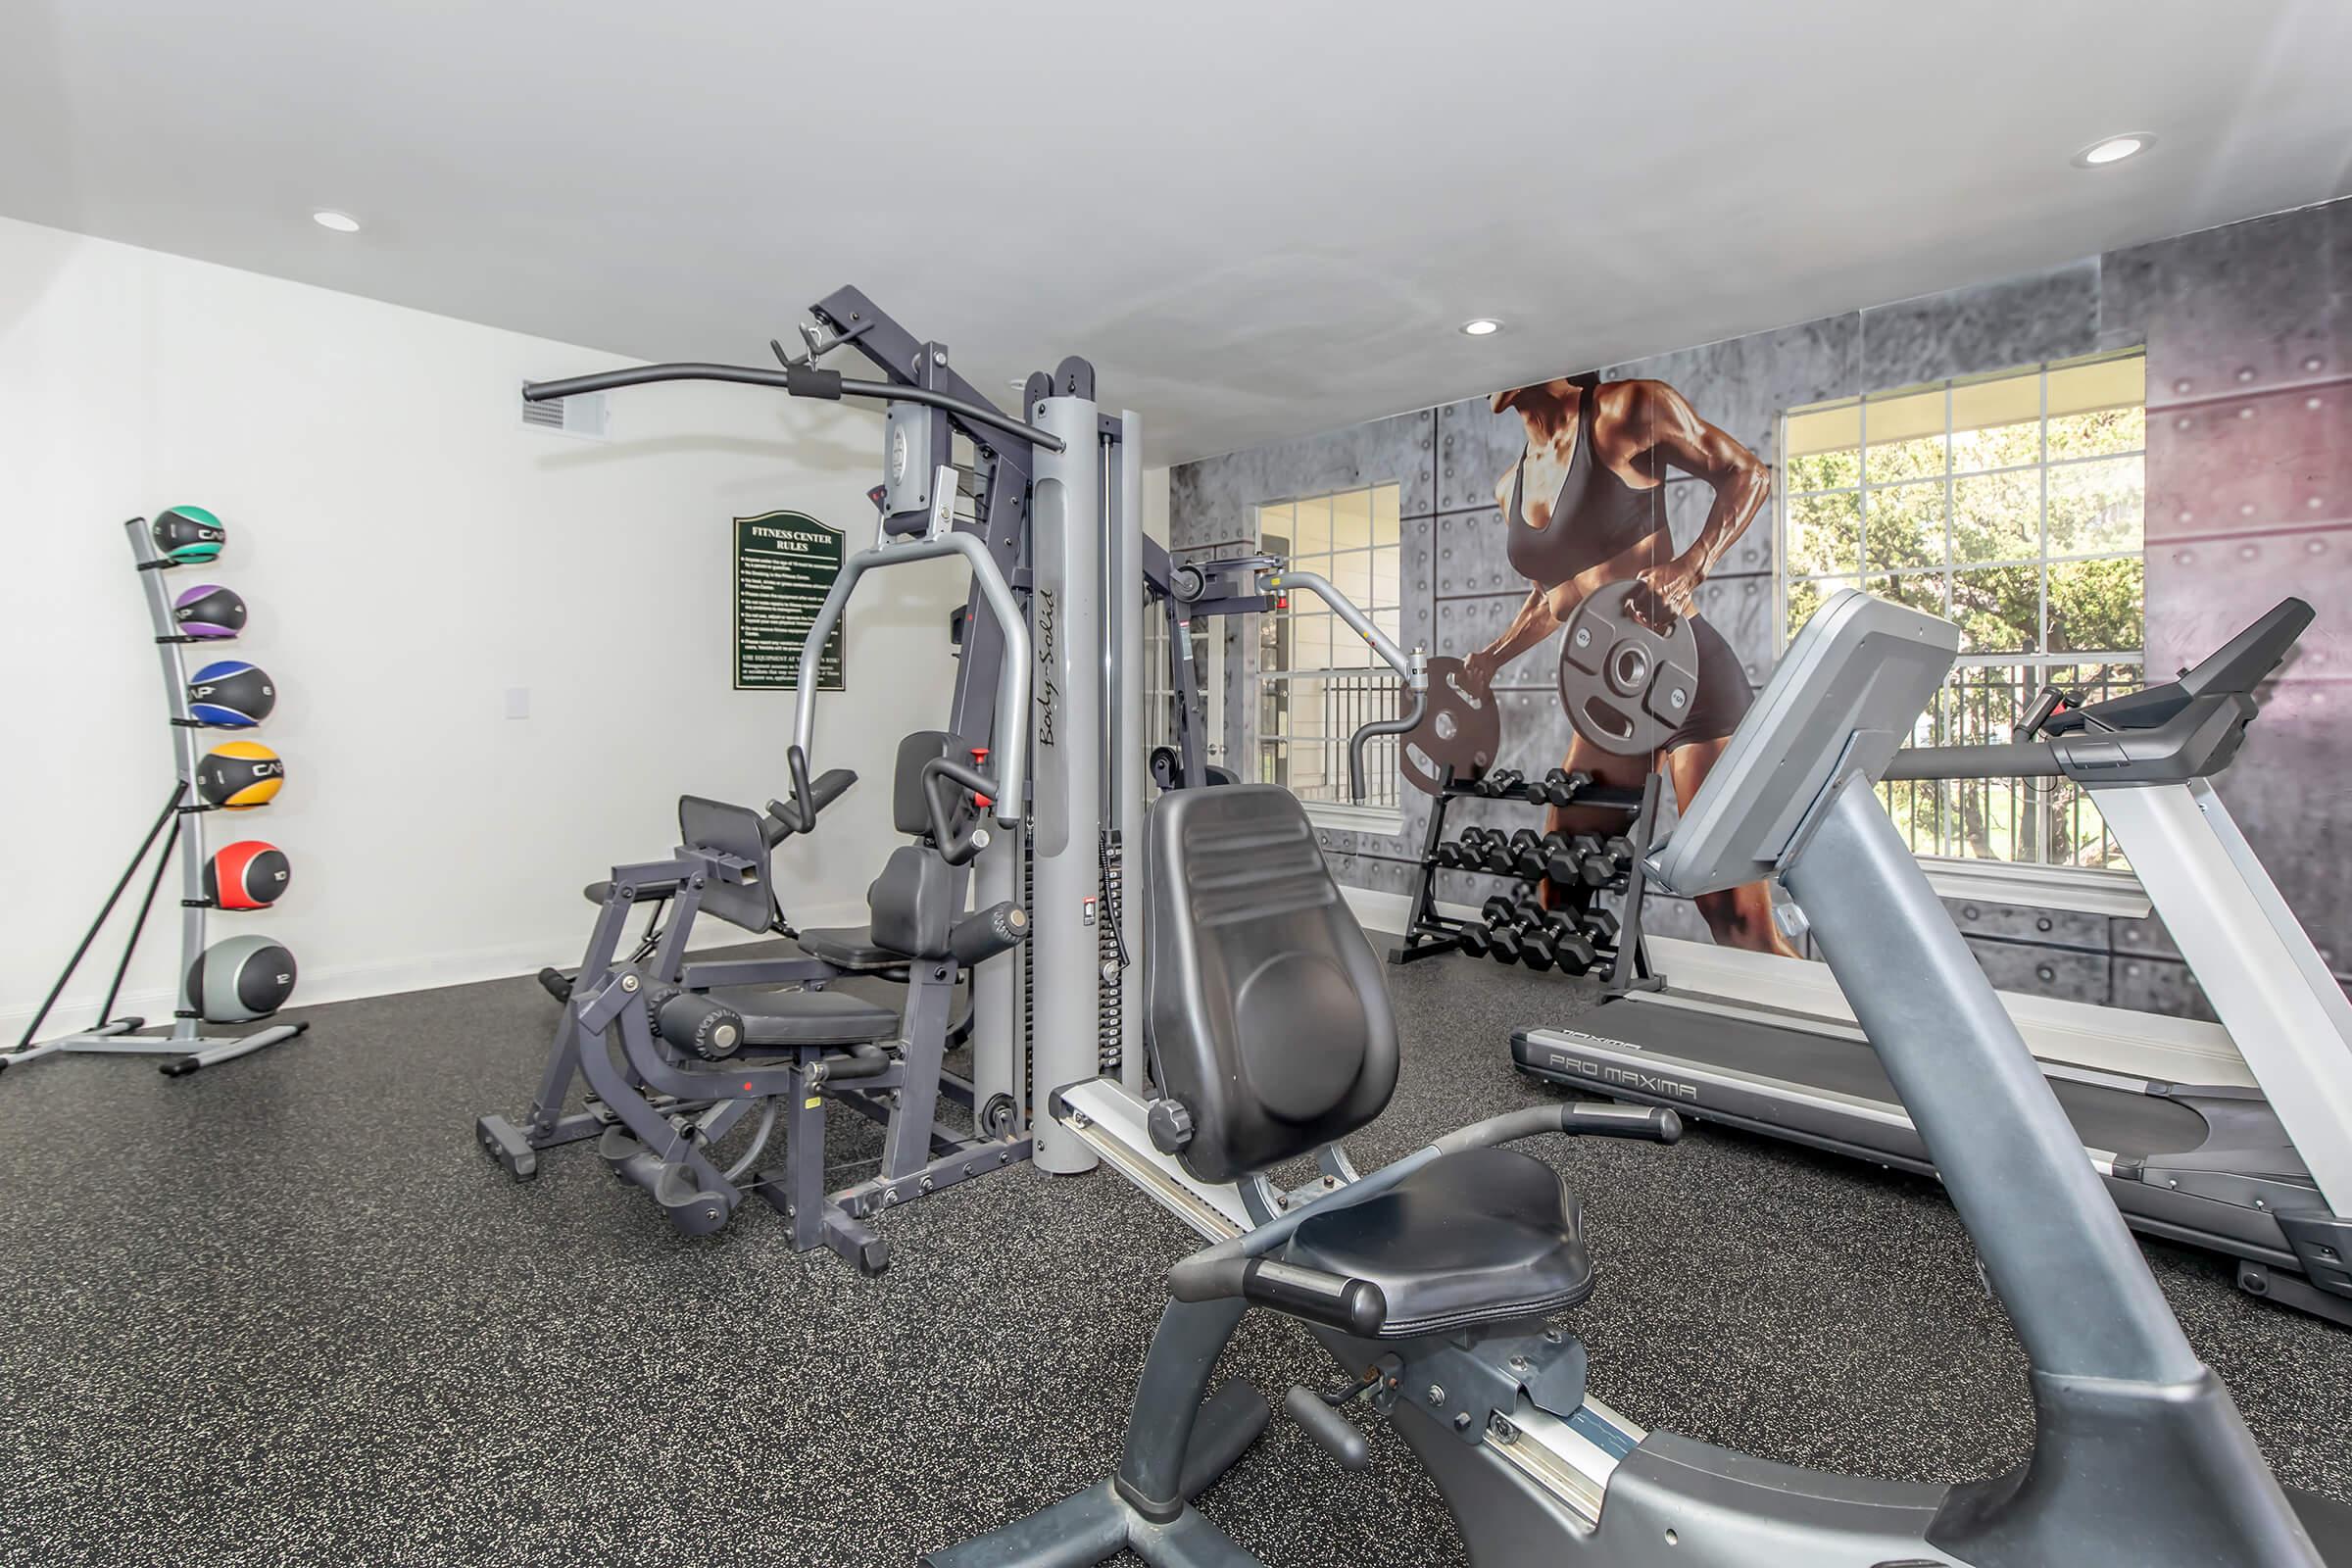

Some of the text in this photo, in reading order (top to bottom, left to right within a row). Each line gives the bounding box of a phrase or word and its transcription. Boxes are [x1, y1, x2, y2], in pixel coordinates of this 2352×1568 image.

[753, 526, 832, 544] FITNESS CENTER
[776, 540, 808, 552] RULES
[1037, 588, 1059, 748] Body-Solid
[274, 870, 287, 881] 10
[275, 973, 290, 985] 12
[1549, 1054, 1697, 1100] PRO MAXIMA
